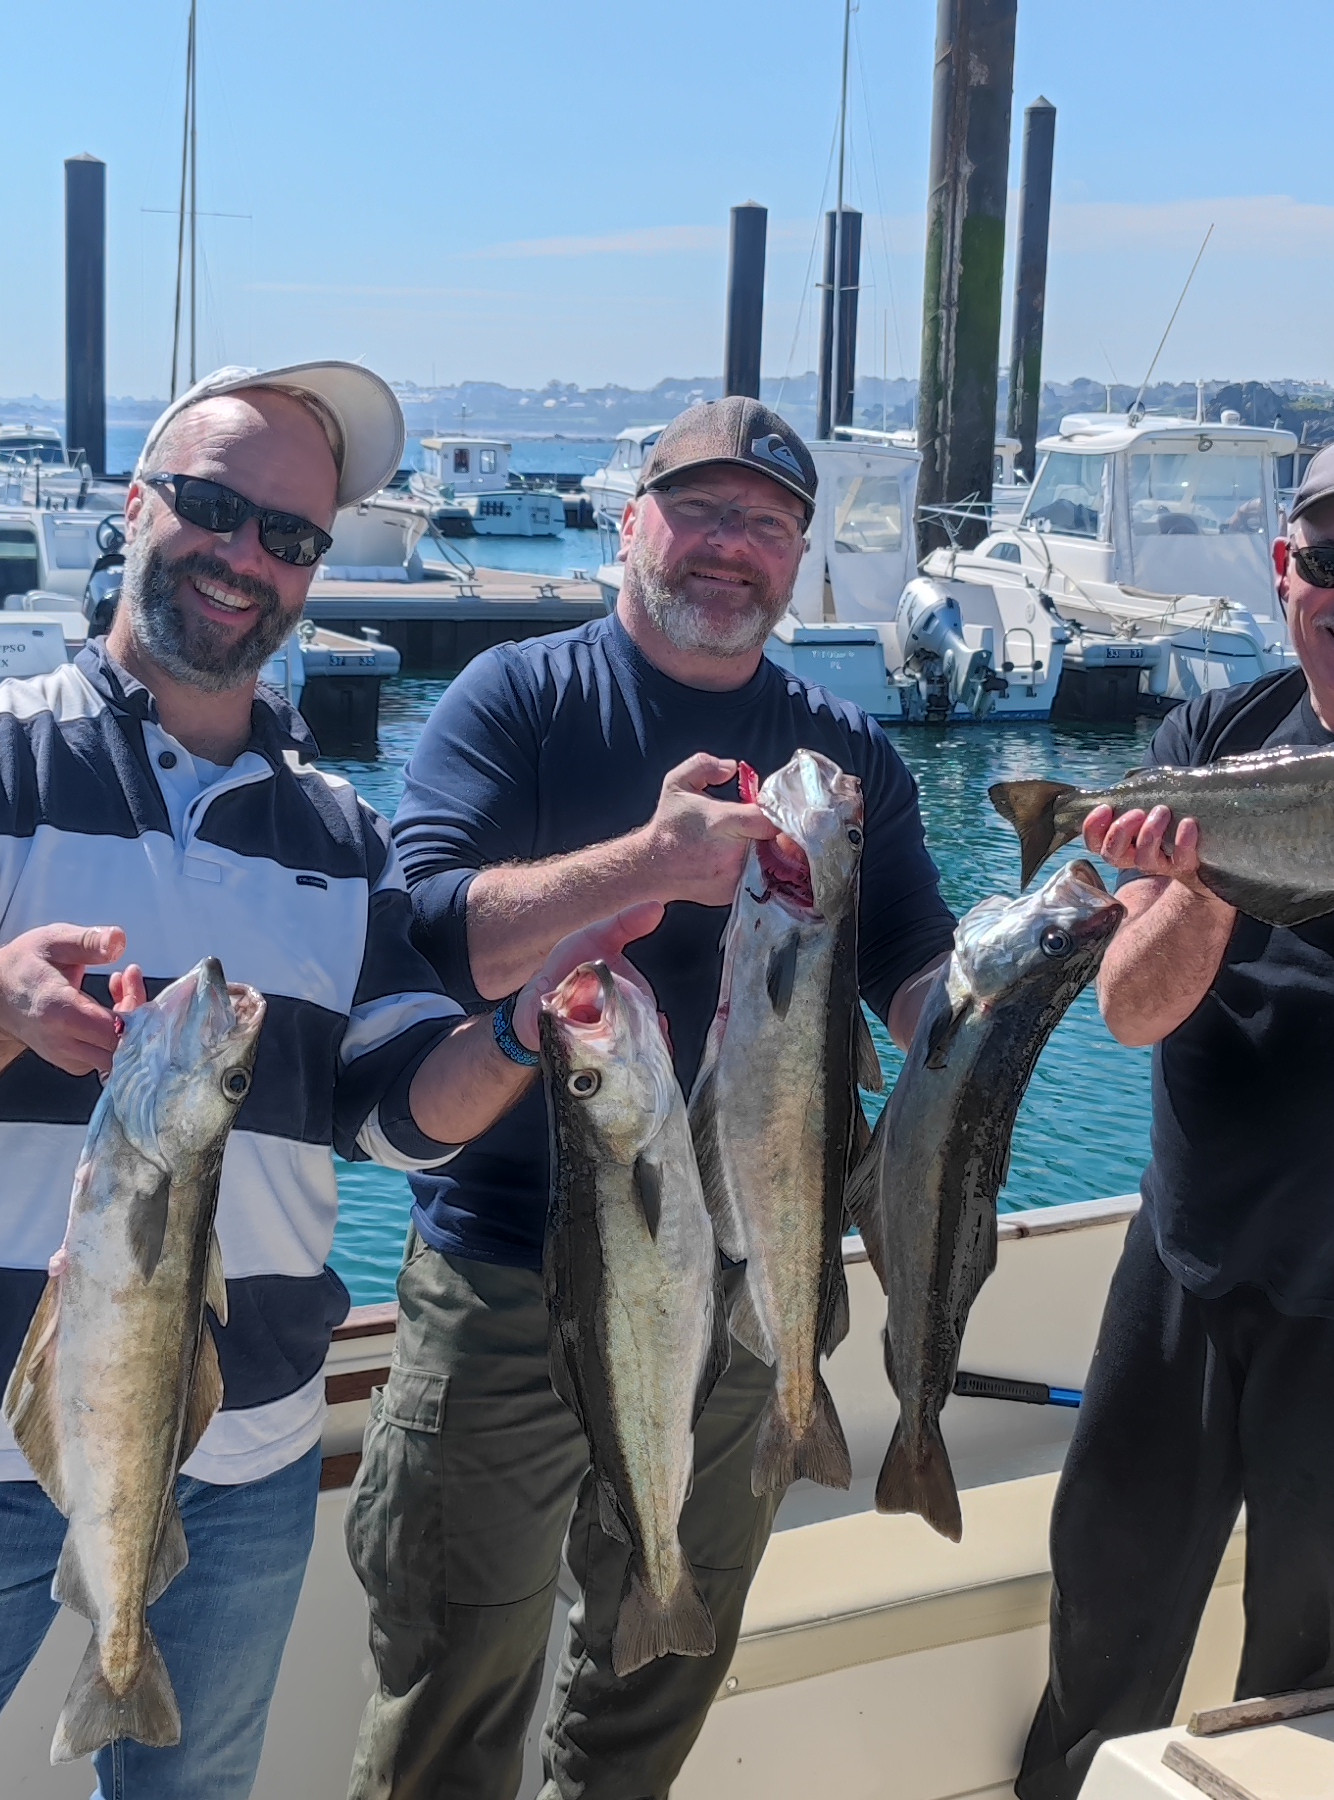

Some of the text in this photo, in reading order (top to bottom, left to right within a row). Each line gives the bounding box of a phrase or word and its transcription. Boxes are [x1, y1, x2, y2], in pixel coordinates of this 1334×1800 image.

[1108, 649, 1143, 658] 33 31
[360, 656, 375, 666] 35
